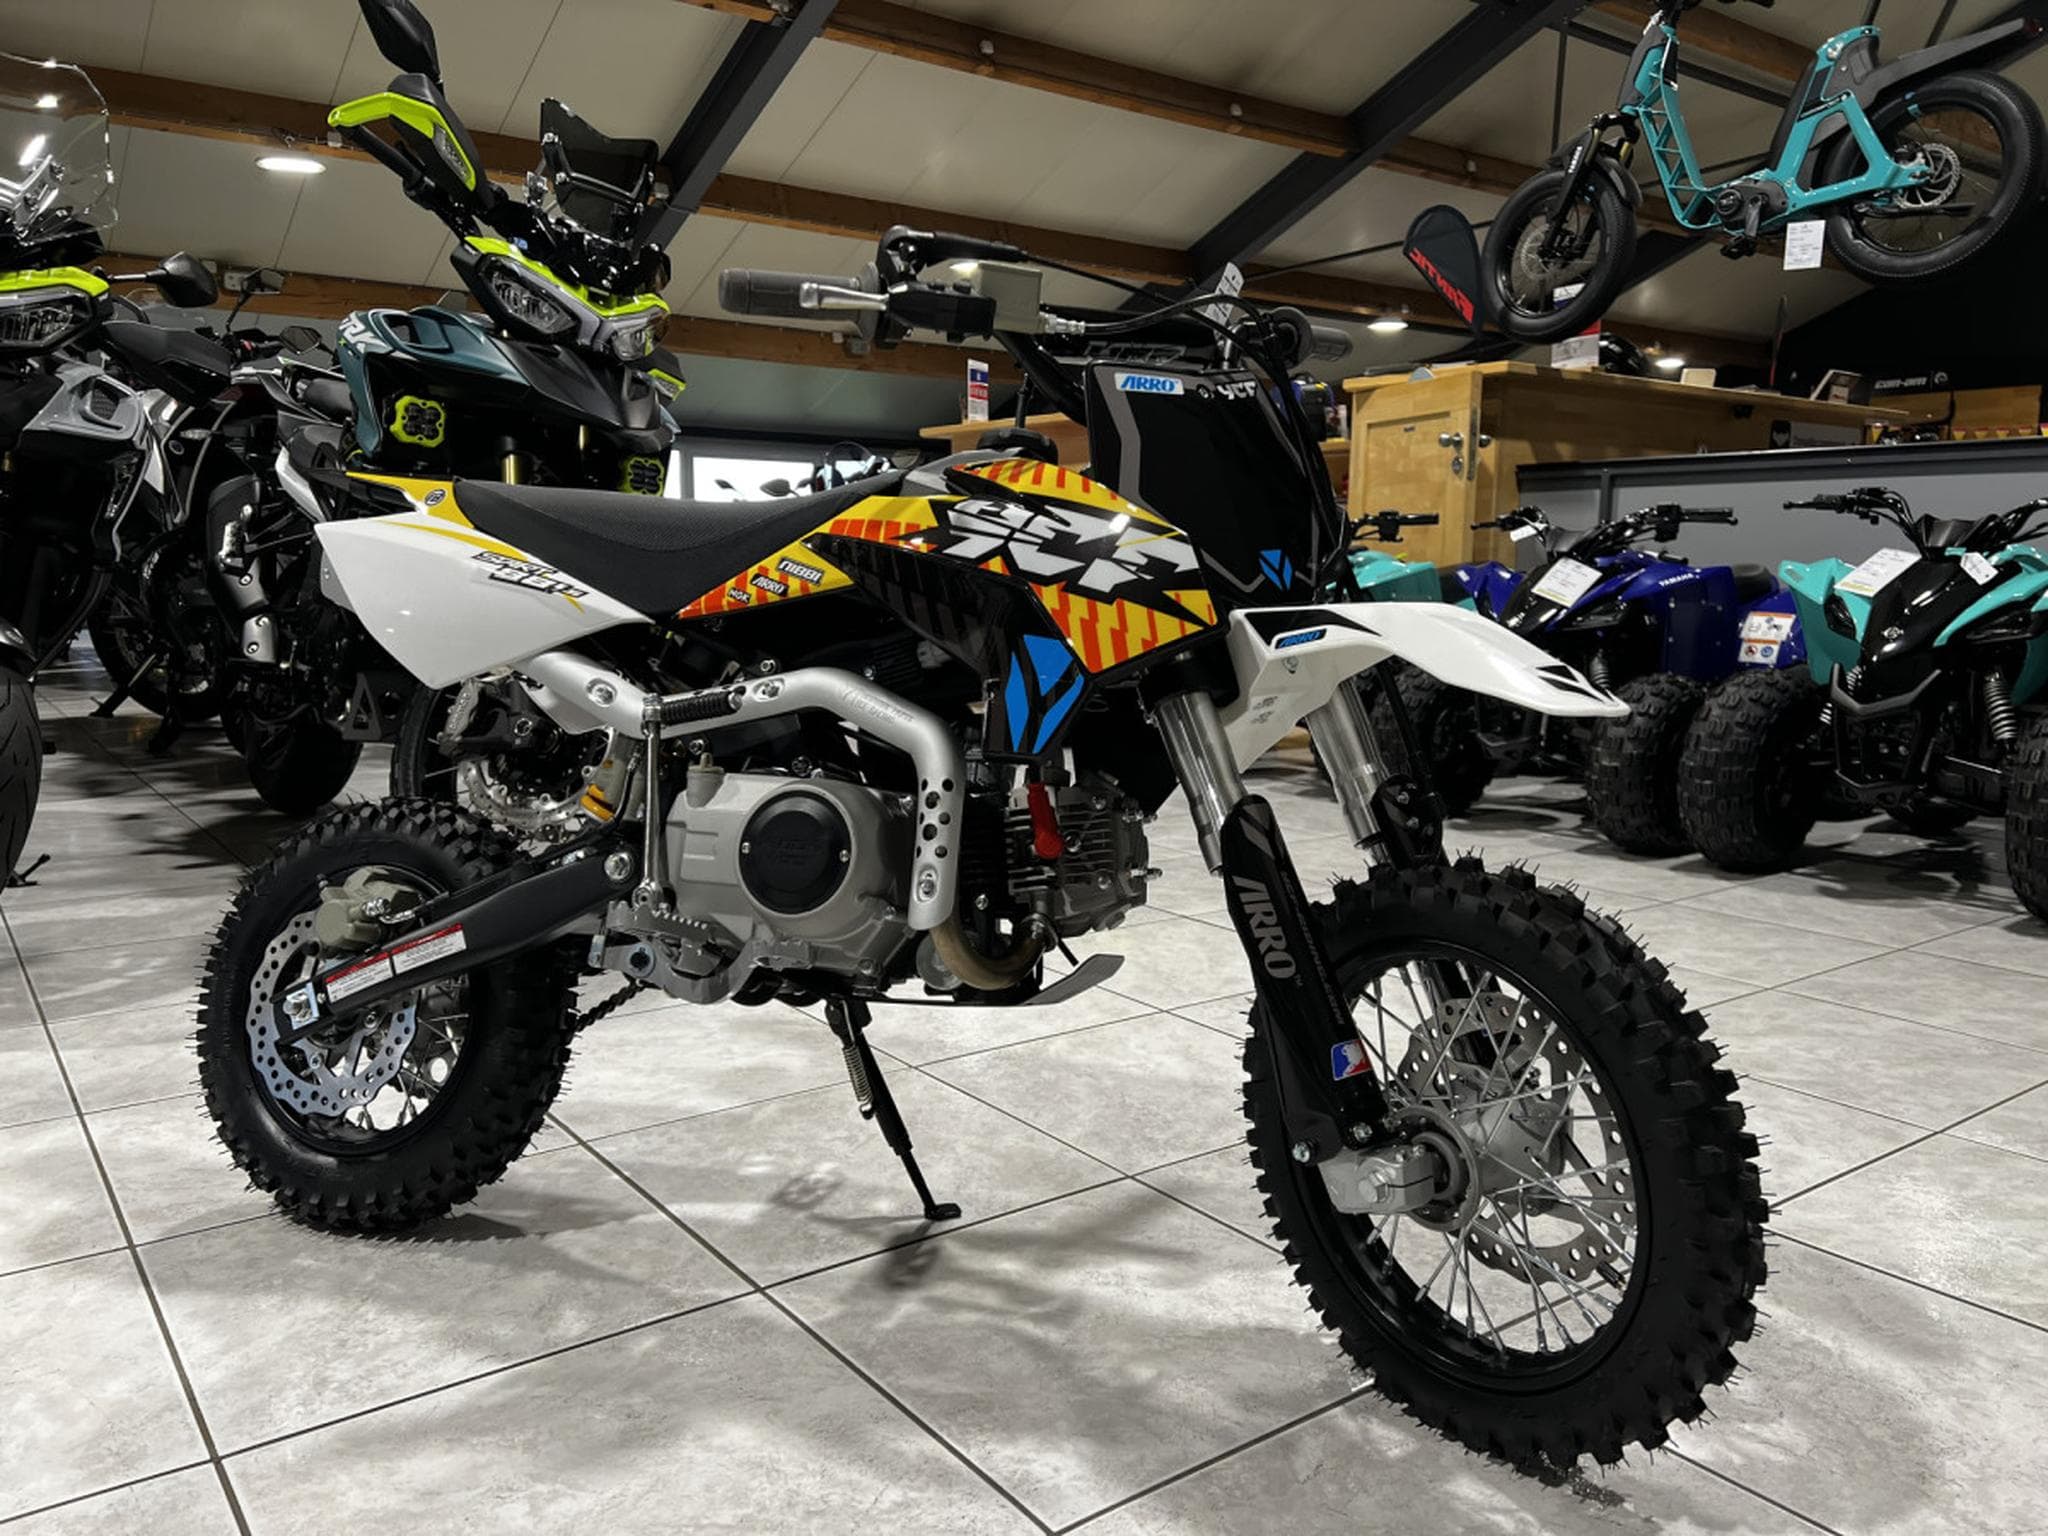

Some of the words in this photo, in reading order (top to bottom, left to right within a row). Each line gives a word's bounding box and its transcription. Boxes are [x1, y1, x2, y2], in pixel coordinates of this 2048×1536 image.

[1121, 375, 1175, 393] ARRO
[1216, 380, 1257, 400] YCF
[752, 575, 786, 595] ARRO
[1658, 572, 1695, 587] YAMAHA
[1233, 876, 1298, 980] ARRO
